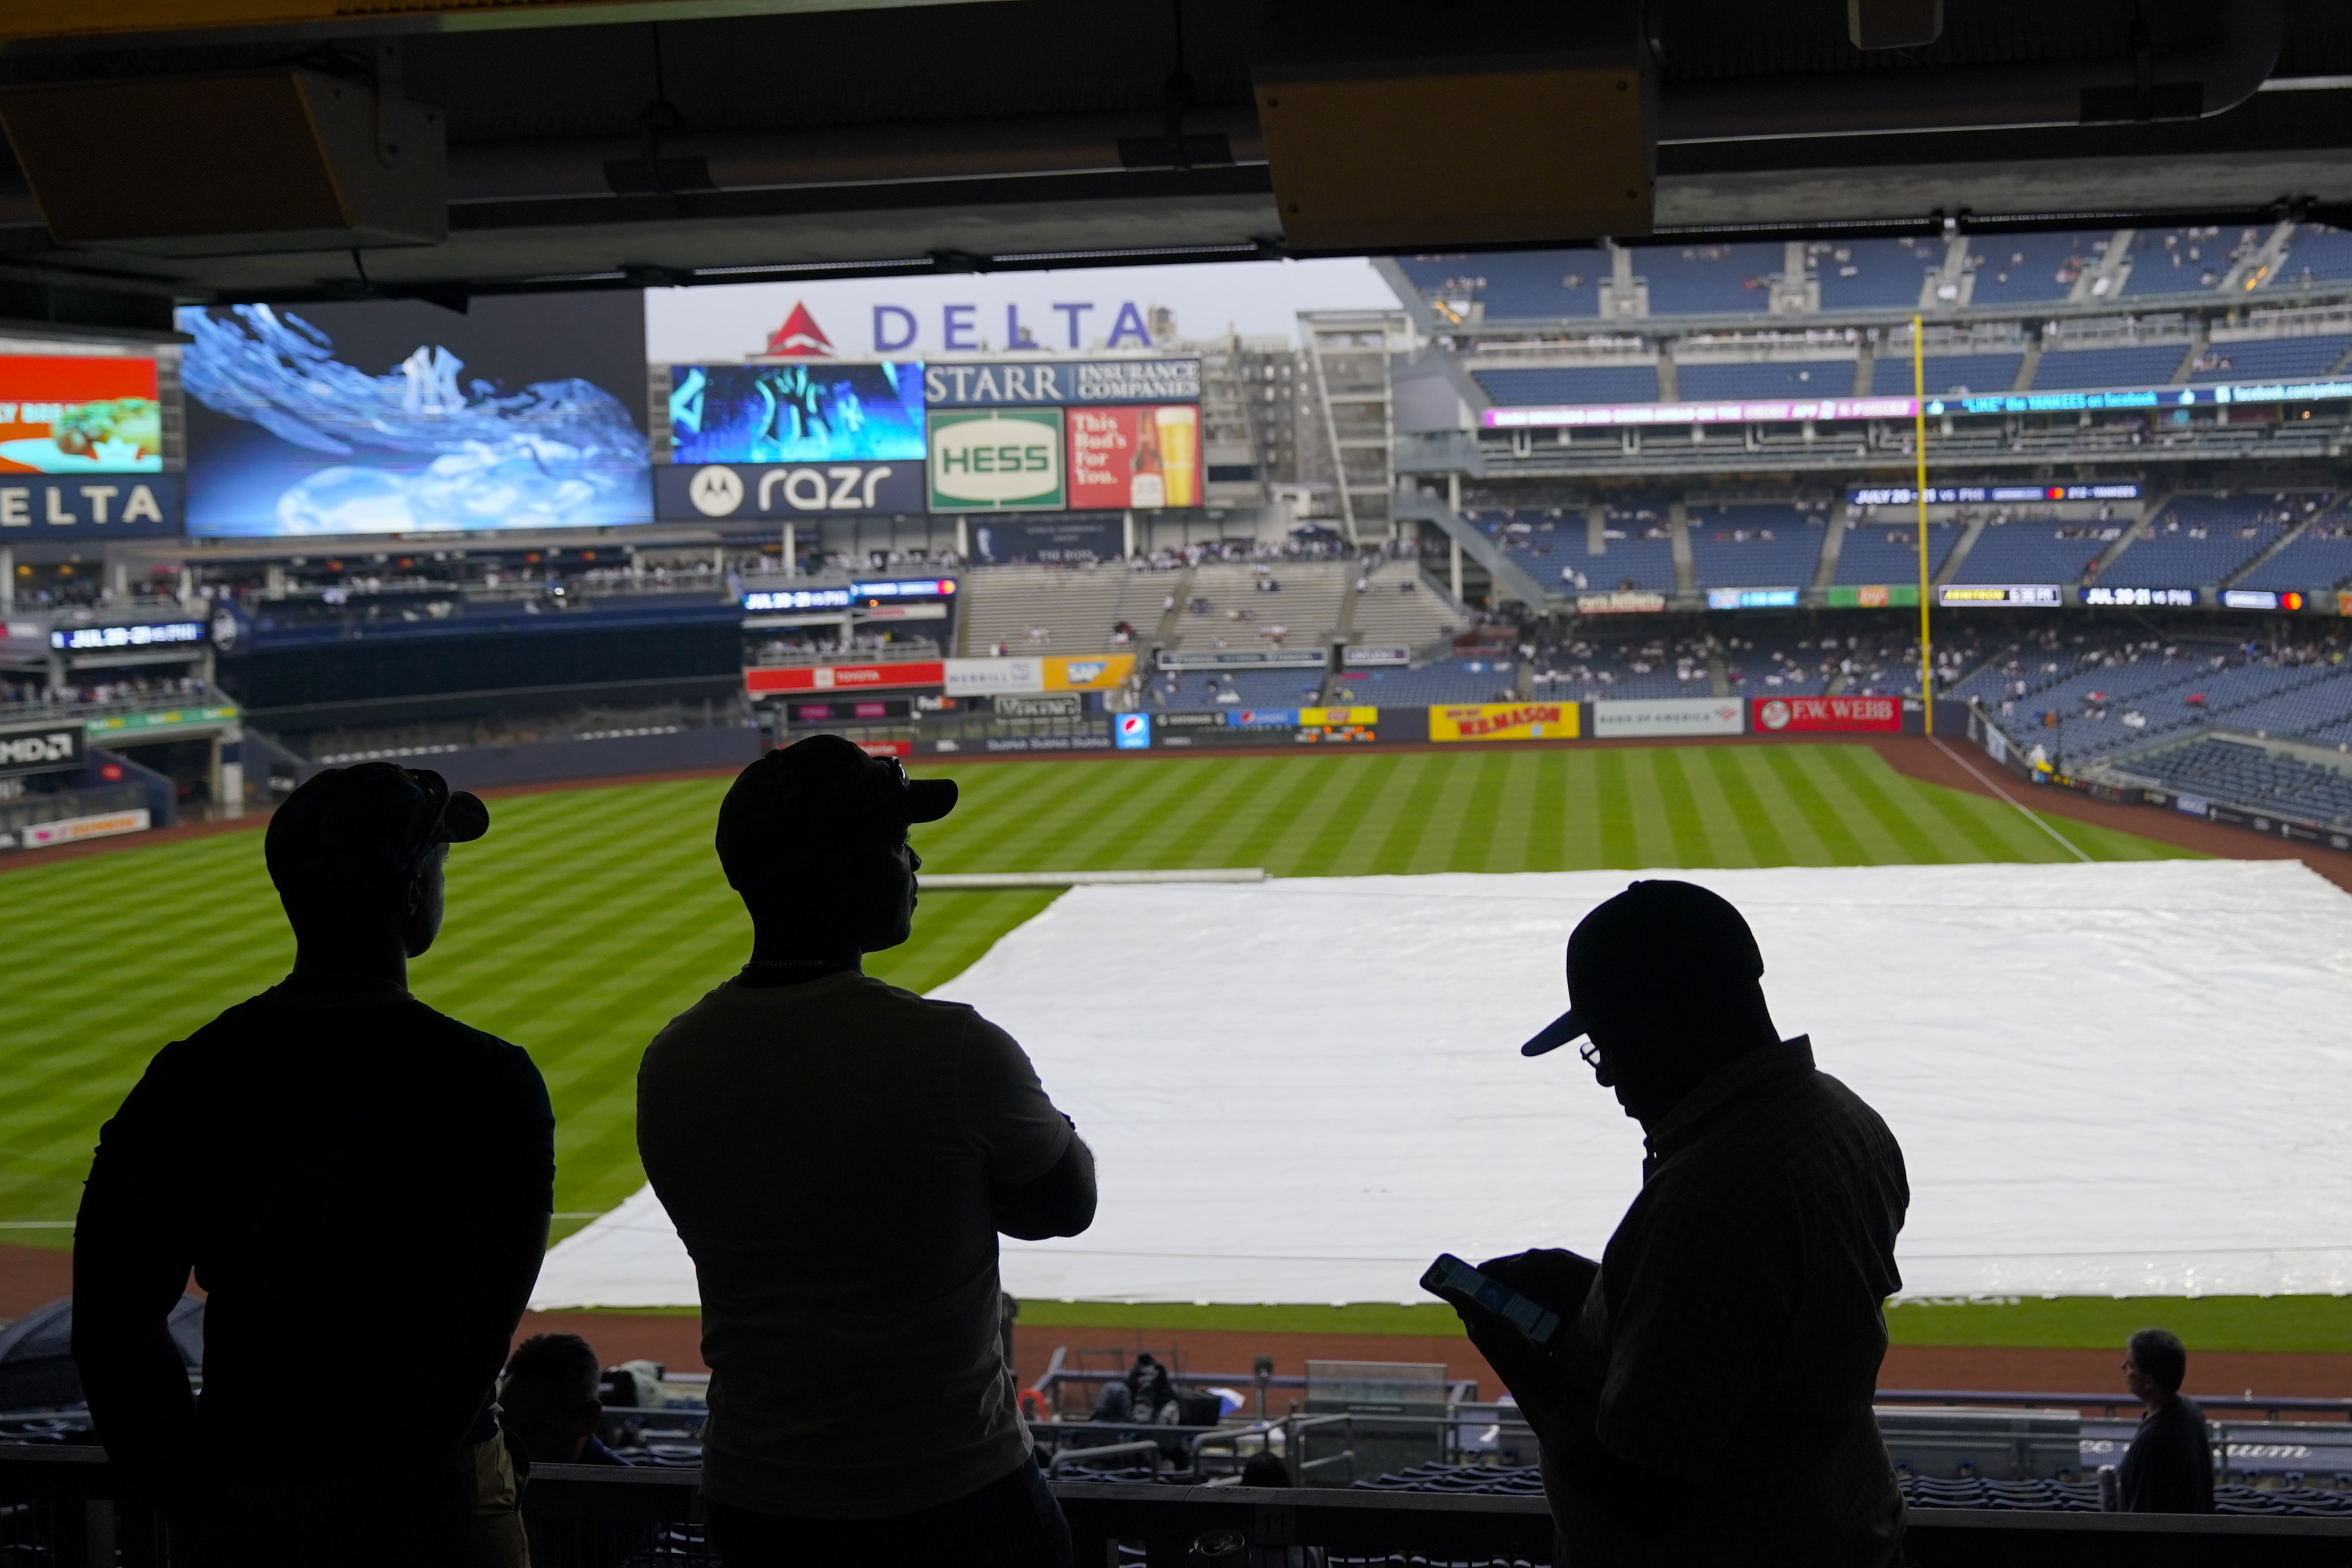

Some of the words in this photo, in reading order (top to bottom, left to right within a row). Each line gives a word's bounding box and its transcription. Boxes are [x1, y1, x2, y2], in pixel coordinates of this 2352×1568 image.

[873, 302, 1152, 351] DELTA
[1079, 360, 1199, 381] INSURANCE
[925, 366, 1065, 401] STARR
[1078, 381, 1200, 399] COMPANIES
[2028, 393, 2086, 410] YANKEES
[2104, 391, 2158, 408] facebook
[1071, 412, 1117, 431] This
[1074, 430, 1127, 449] Bud's
[943, 446, 1048, 473] HESS
[1075, 451, 1108, 467] For
[1075, 467, 1117, 485] You.
[758, 466, 892, 511] razr
[1856, 489, 1891, 504] JULY
[1958, 488, 1985, 502] PHI
[0, 485, 163, 526] ELTA
[745, 594, 773, 610] JUL
[2086, 588, 2115, 605] JUL
[2168, 589, 2192, 606] PHI
[69, 629, 106, 649] JUL
[837, 669, 880, 682] TOYOTA
[1068, 662, 1102, 683] SAP
[917, 695, 956, 710] FedEx
[1792, 700, 1829, 719] F.W.
[1832, 700, 1894, 720] WEBB
[0, 737, 47, 764] MD
